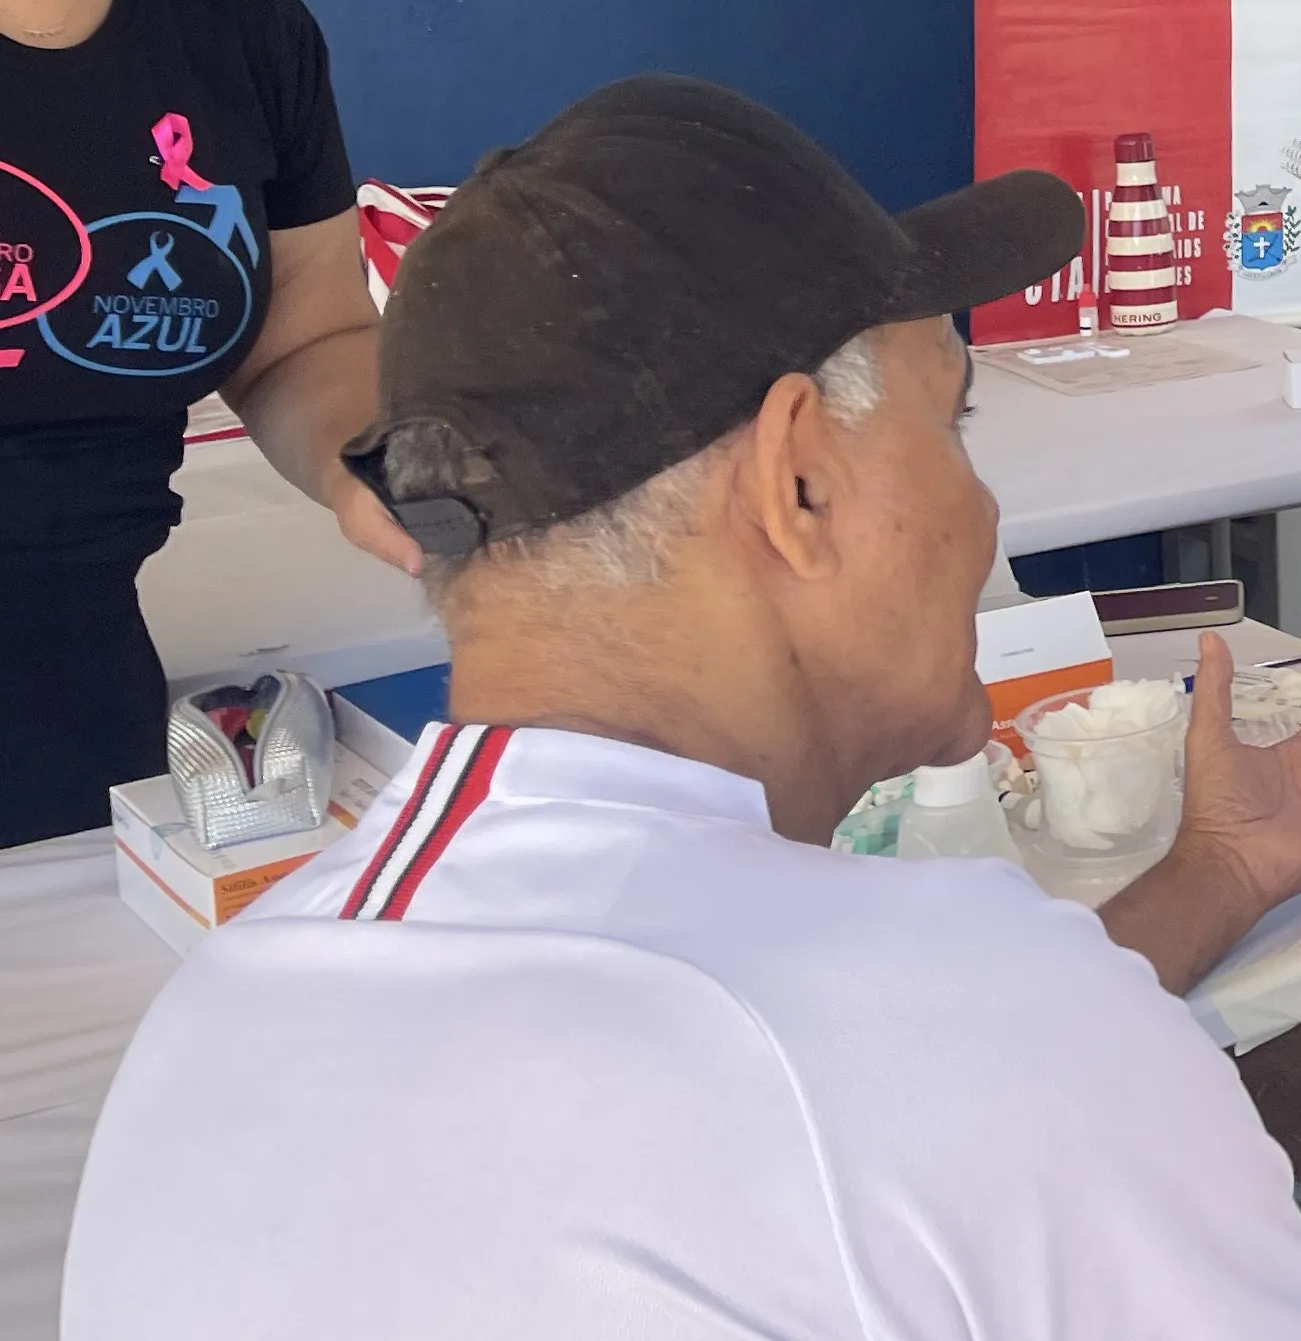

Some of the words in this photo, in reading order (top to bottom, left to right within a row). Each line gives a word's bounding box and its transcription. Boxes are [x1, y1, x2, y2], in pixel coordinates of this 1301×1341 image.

[1188, 210, 1205, 232] DE
[92, 294, 220, 318] NOVEMBRO
[1114, 312, 1162, 325] HERING
[86, 313, 207, 354] AZUL
